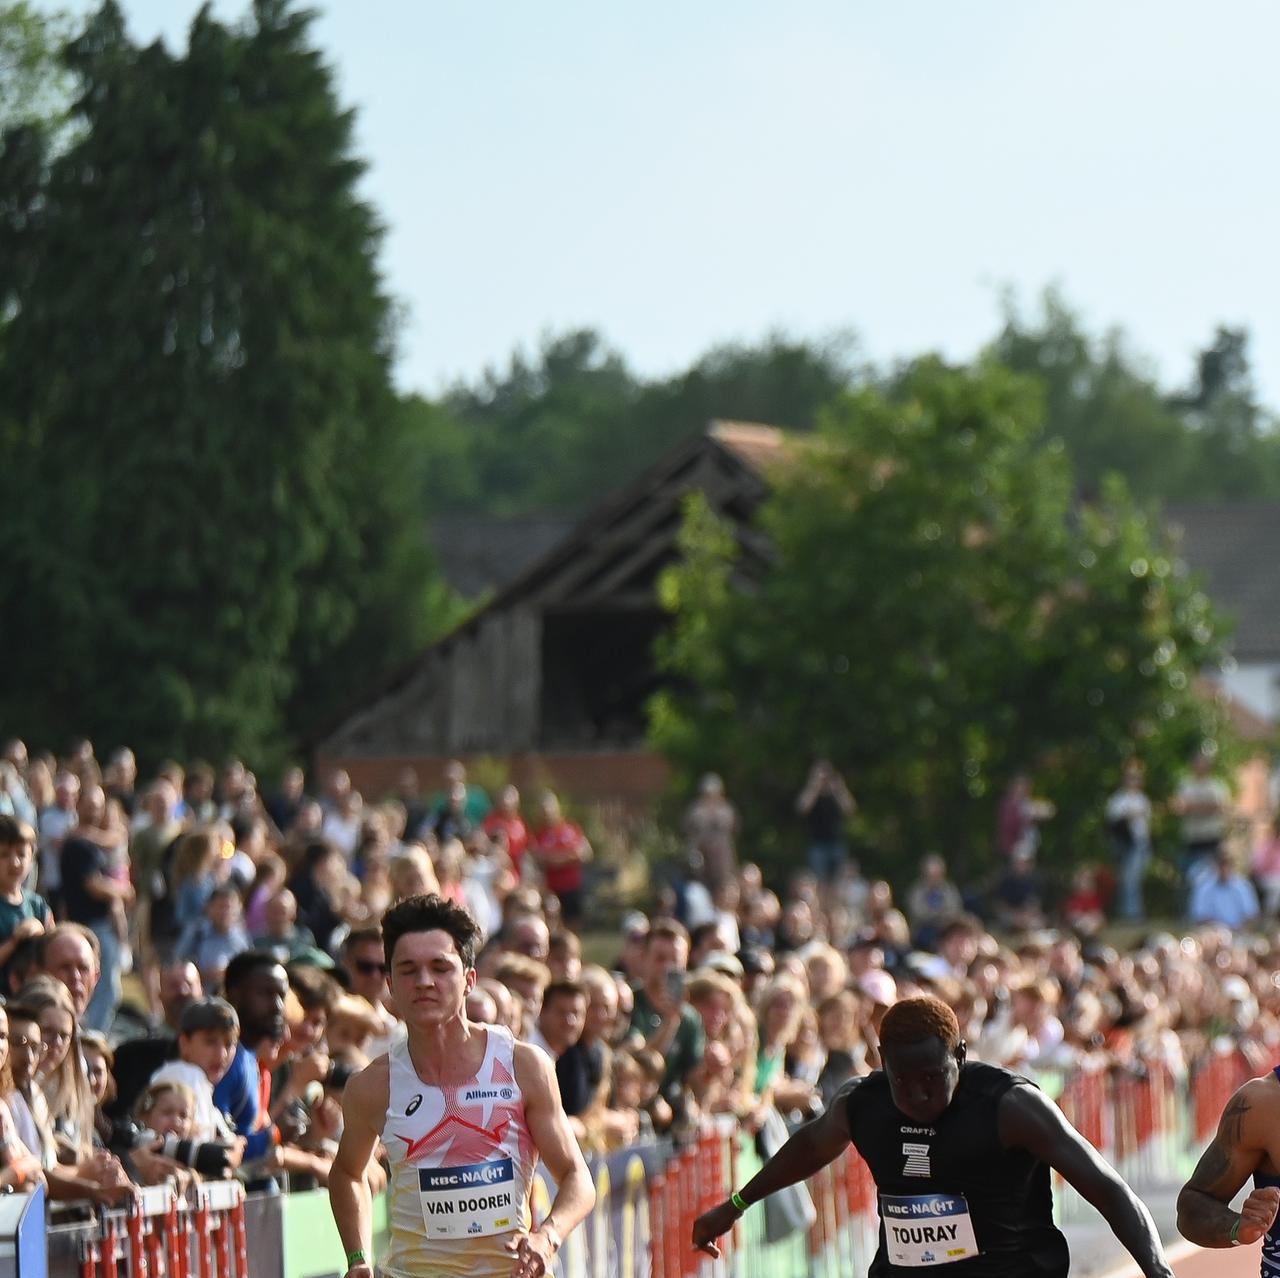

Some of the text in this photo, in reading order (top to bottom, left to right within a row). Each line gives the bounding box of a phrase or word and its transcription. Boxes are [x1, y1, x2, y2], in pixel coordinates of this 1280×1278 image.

[465, 1090, 498, 1101] Allianz
[900, 1126, 929, 1135] CRAFT
[427, 1192, 512, 1215] VAN DOOREN
[892, 1223, 958, 1244] TOURAY
